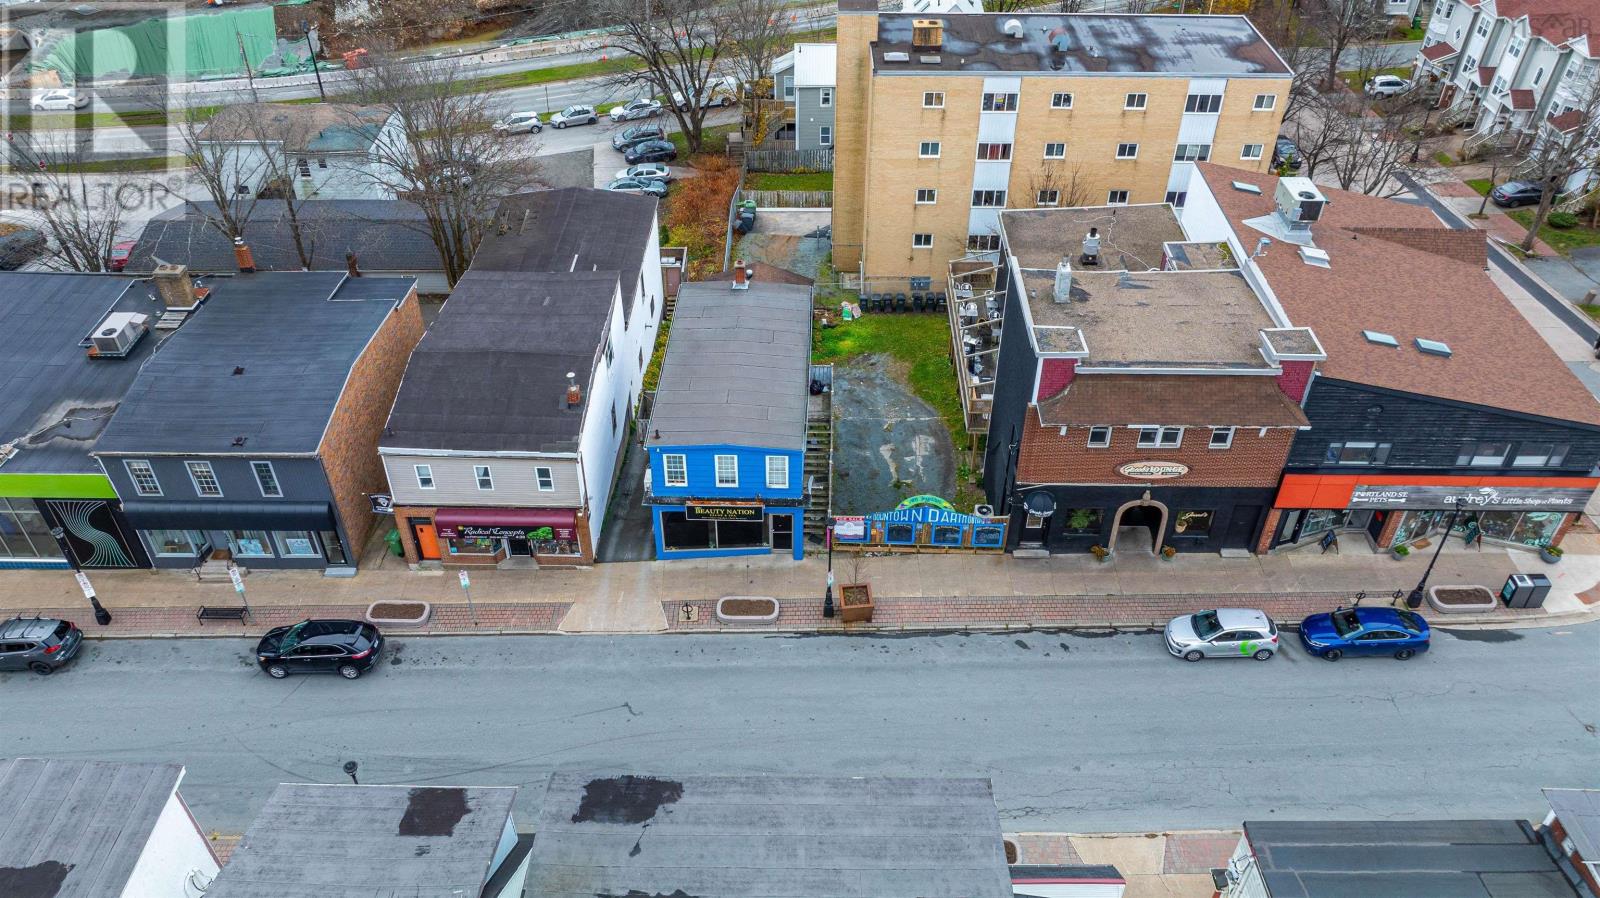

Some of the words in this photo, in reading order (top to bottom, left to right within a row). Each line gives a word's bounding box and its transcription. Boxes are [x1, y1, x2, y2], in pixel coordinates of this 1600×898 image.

[1150, 466, 1185, 474] LOUNGE
[1501, 497, 1523, 505] Little
[1523, 497, 1541, 506] Shop
[694, 506, 725, 515] BEAUTY
[726, 508, 756, 516] NATION
[464, 526, 492, 537] Radical
[491, 527, 526, 538] Concepts
